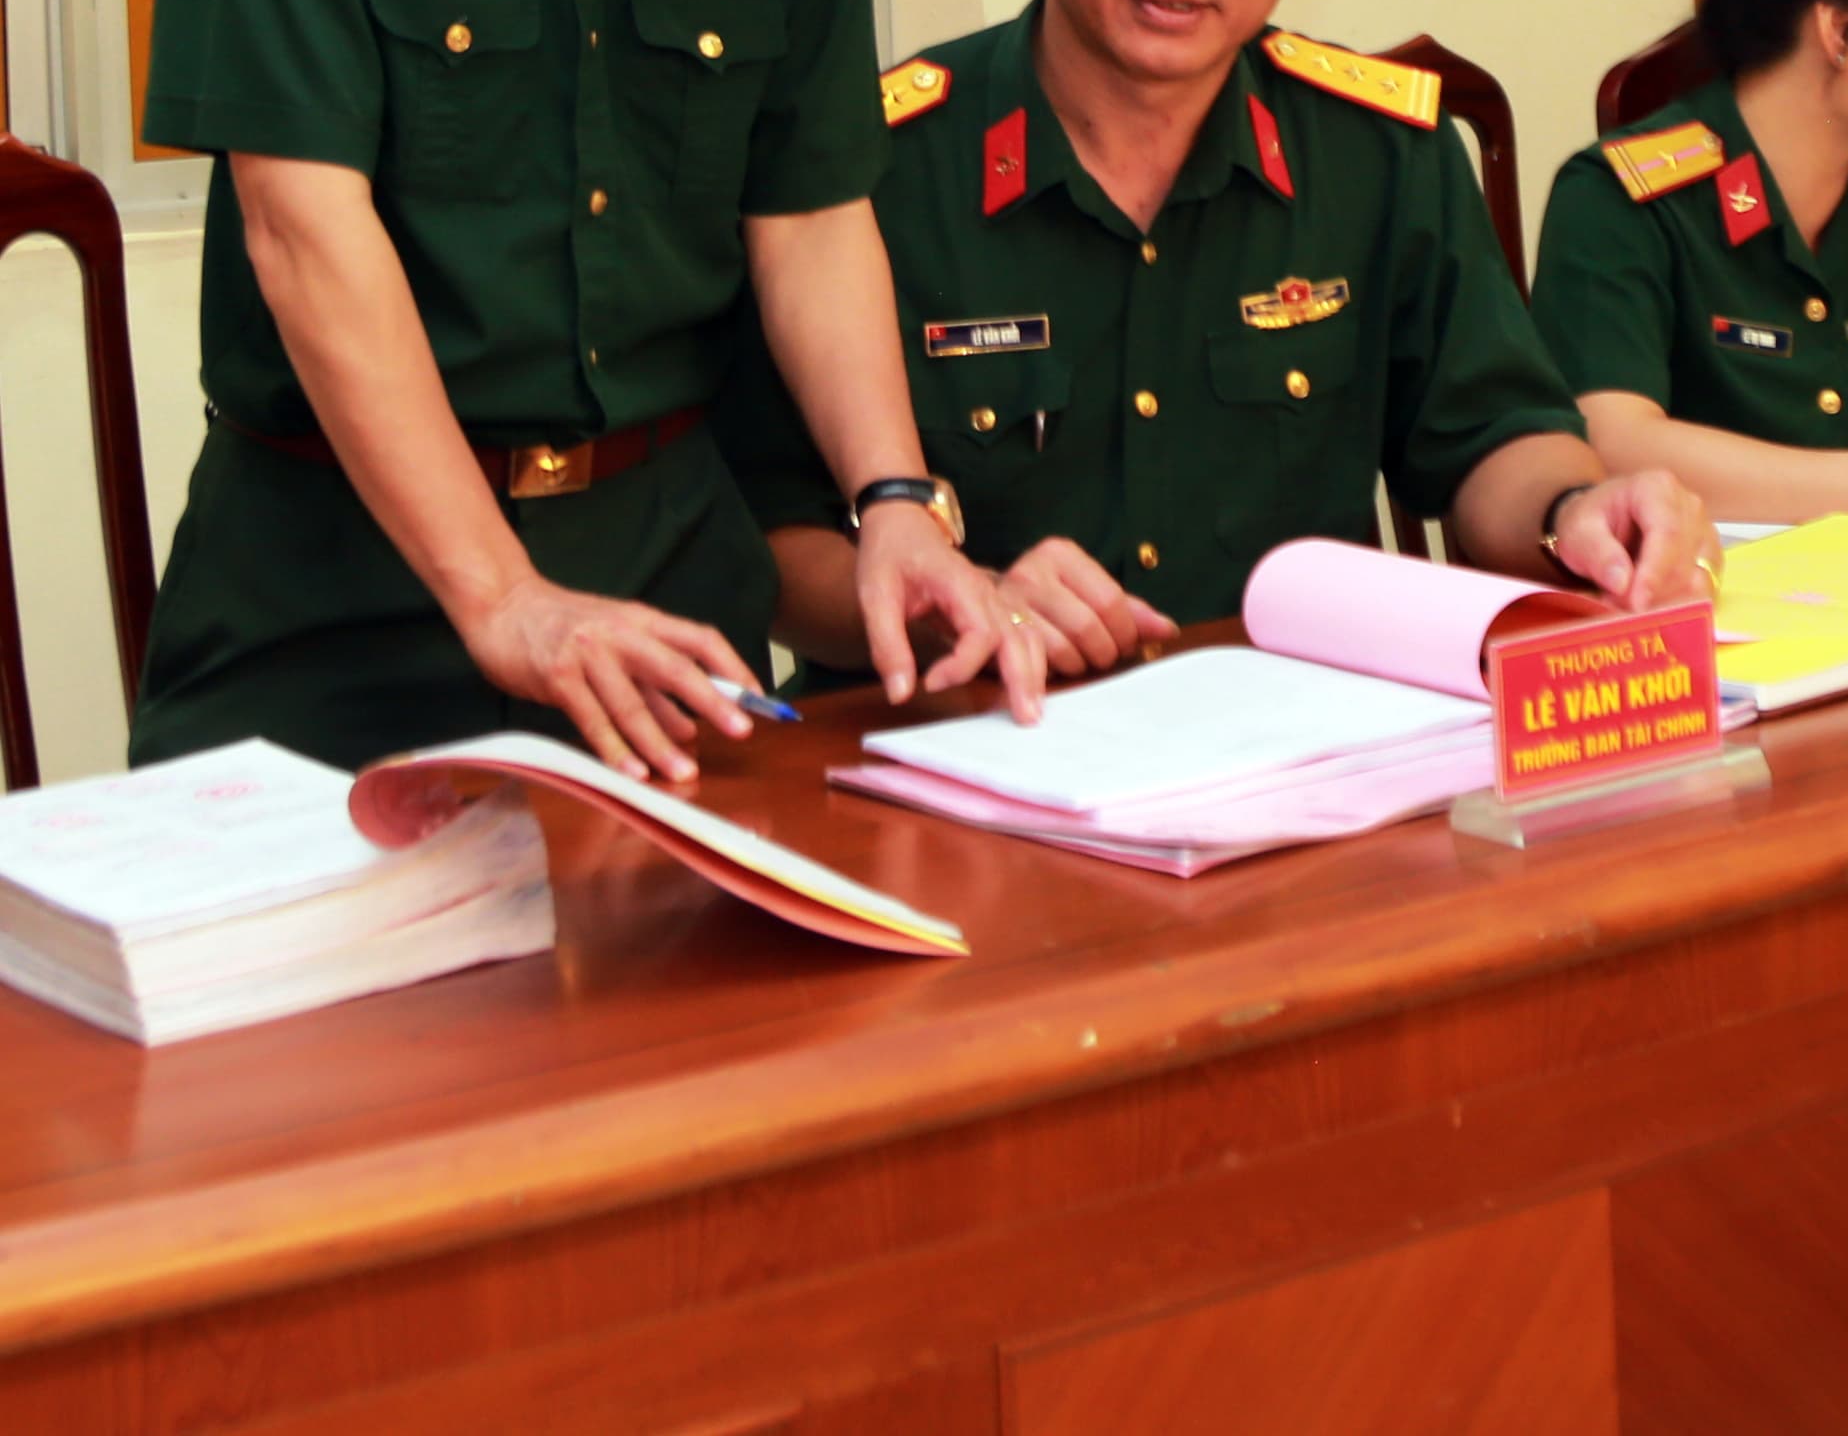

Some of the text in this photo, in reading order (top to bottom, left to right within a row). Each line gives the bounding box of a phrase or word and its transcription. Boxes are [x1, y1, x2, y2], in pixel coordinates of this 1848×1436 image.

[1547, 637, 1633, 679] THƯỢNG
[1524, 656, 1692, 732] LÊ VĂN KHỞI
[1513, 709, 1707, 774] TRƯỞNG BAN TÀI CHÍNH
